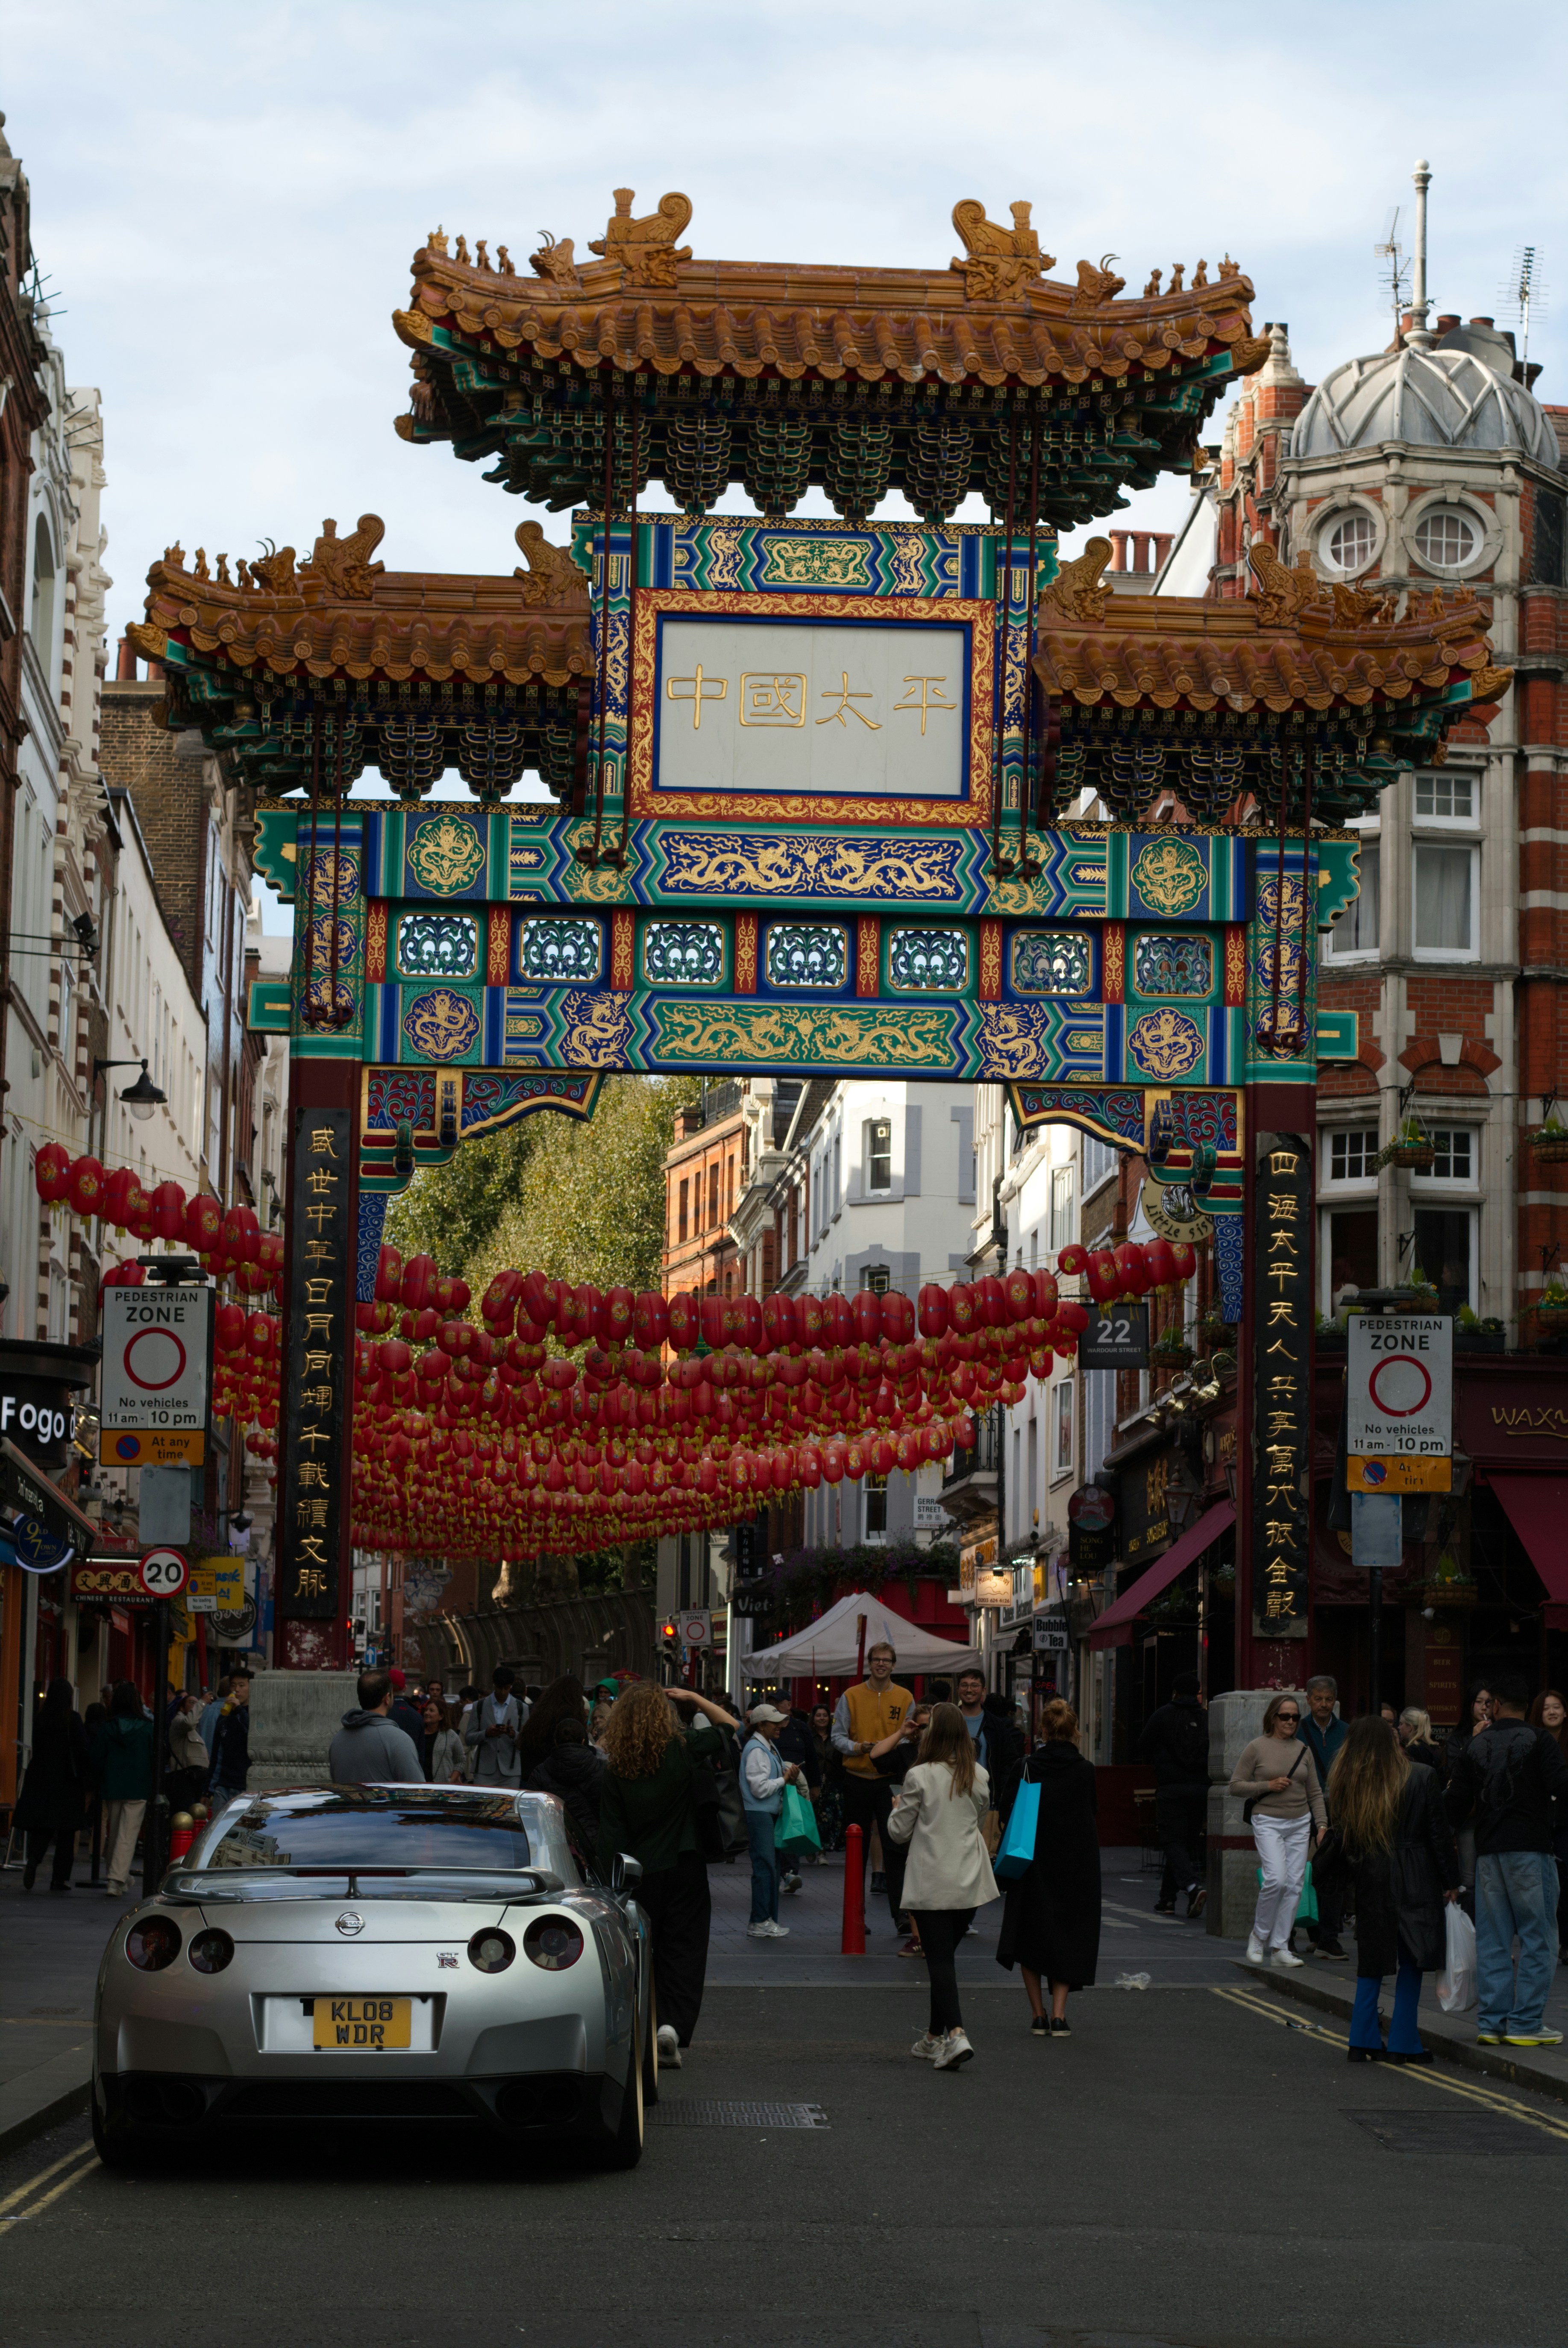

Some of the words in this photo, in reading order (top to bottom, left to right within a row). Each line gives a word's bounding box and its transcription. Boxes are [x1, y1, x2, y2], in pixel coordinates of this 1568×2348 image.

[667, 663, 957, 736] 中國太平
[115, 1292, 198, 1302] PEDESTRIAN
[126, 1306, 185, 1322] ZONE
[1097, 1319, 1130, 1343] 22
[1360, 1320, 1442, 1330] PEDESTRIAN
[1371, 1335, 1430, 1350] ZONE
[119, 1397, 135, 1407] No
[140, 1398, 188, 1407] vehicles
[0, 1395, 65, 1444] Fogo
[1365, 1424, 1381, 1433] No
[1386, 1424, 1434, 1434] vehicles
[152, 1437, 165, 1446] At
[170, 1438, 189, 1448] any
[158, 1449, 183, 1459] time
[147, 1562, 182, 1583] 20
[978, 1576, 994, 1584] Massage
[737, 1596, 769, 1612] Viet
[1036, 1619, 1068, 1632] Bubble
[1048, 1634, 1063, 1647] Tea
[1035, 1681, 1056, 1690] OPEN
[332, 2002, 393, 2021] KL08
[336, 2024, 384, 2044] WDR
